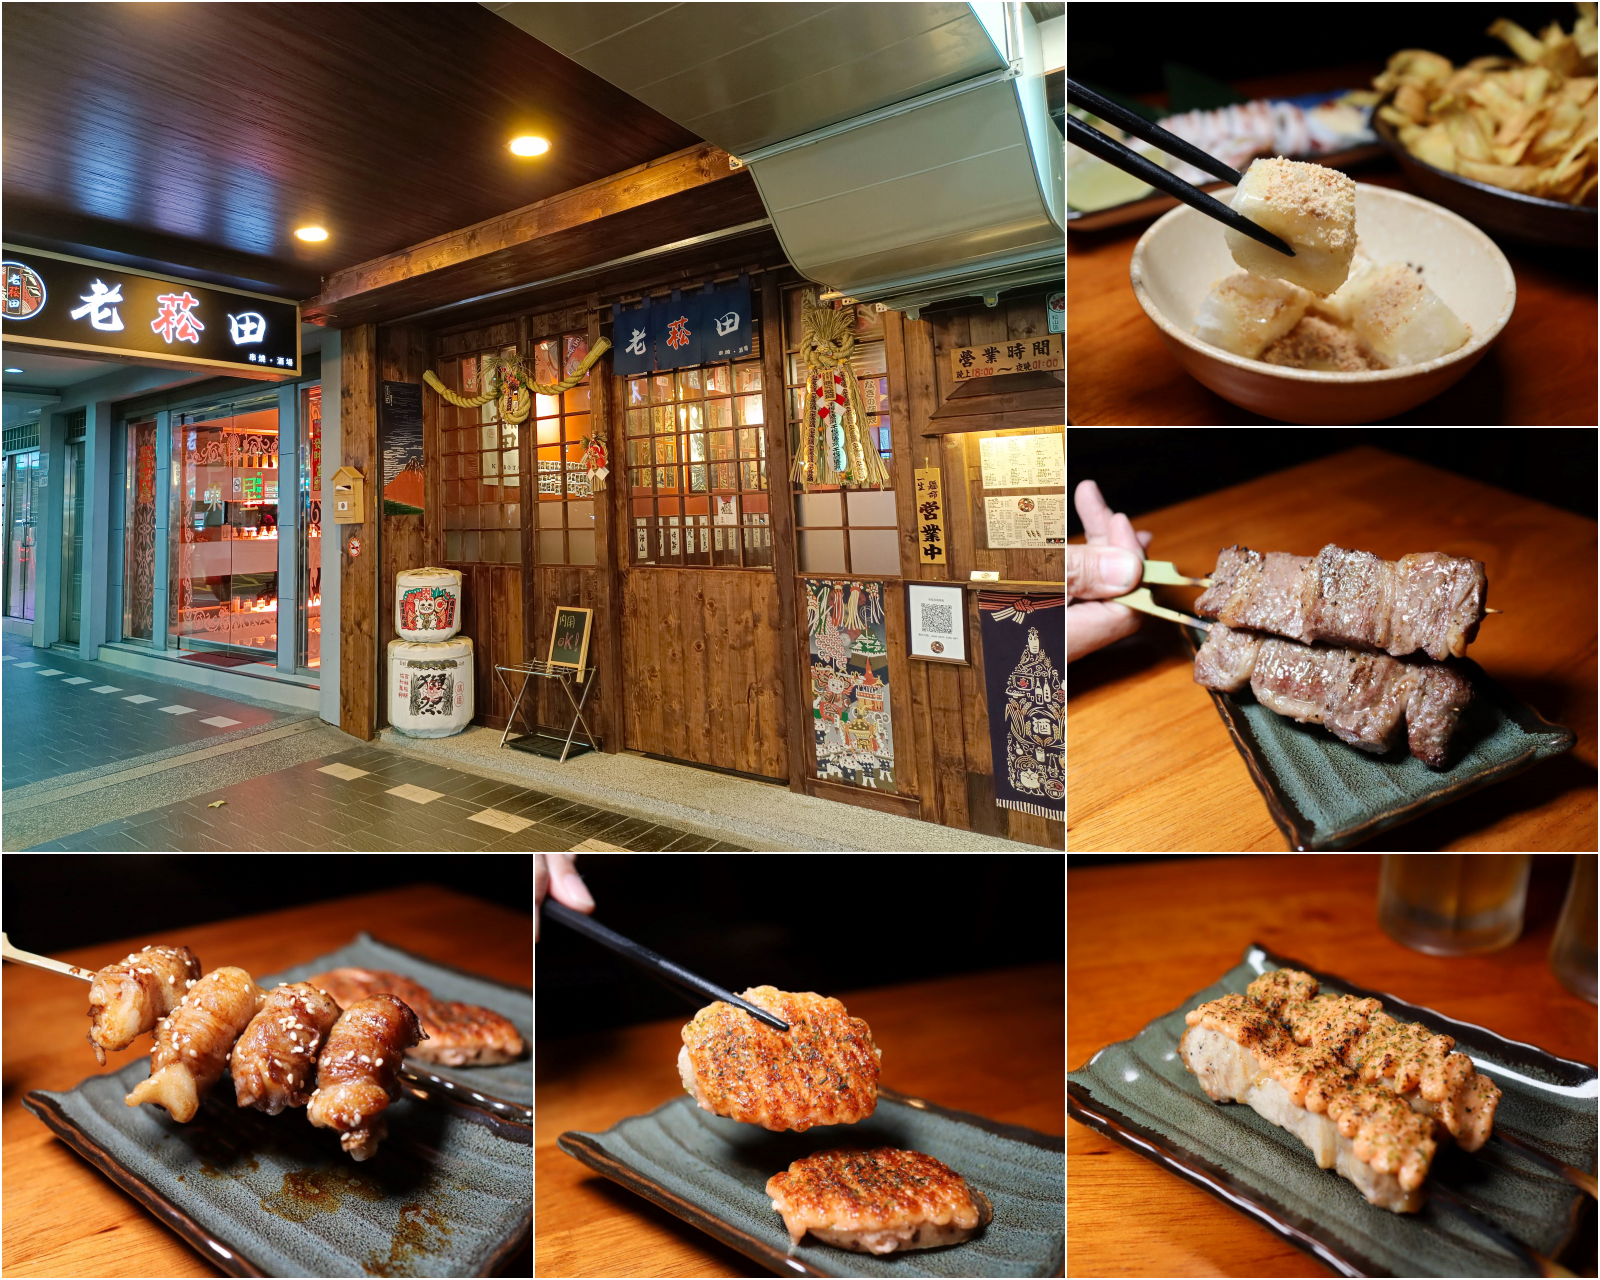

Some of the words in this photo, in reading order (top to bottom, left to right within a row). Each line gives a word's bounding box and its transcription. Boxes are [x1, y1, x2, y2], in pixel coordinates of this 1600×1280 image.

[8, 273, 21, 308] 老菘田
[70, 278, 267, 345] 老菘田
[625, 311, 740, 356] 老菘田
[958, 339, 1051, 368] 營業時間
